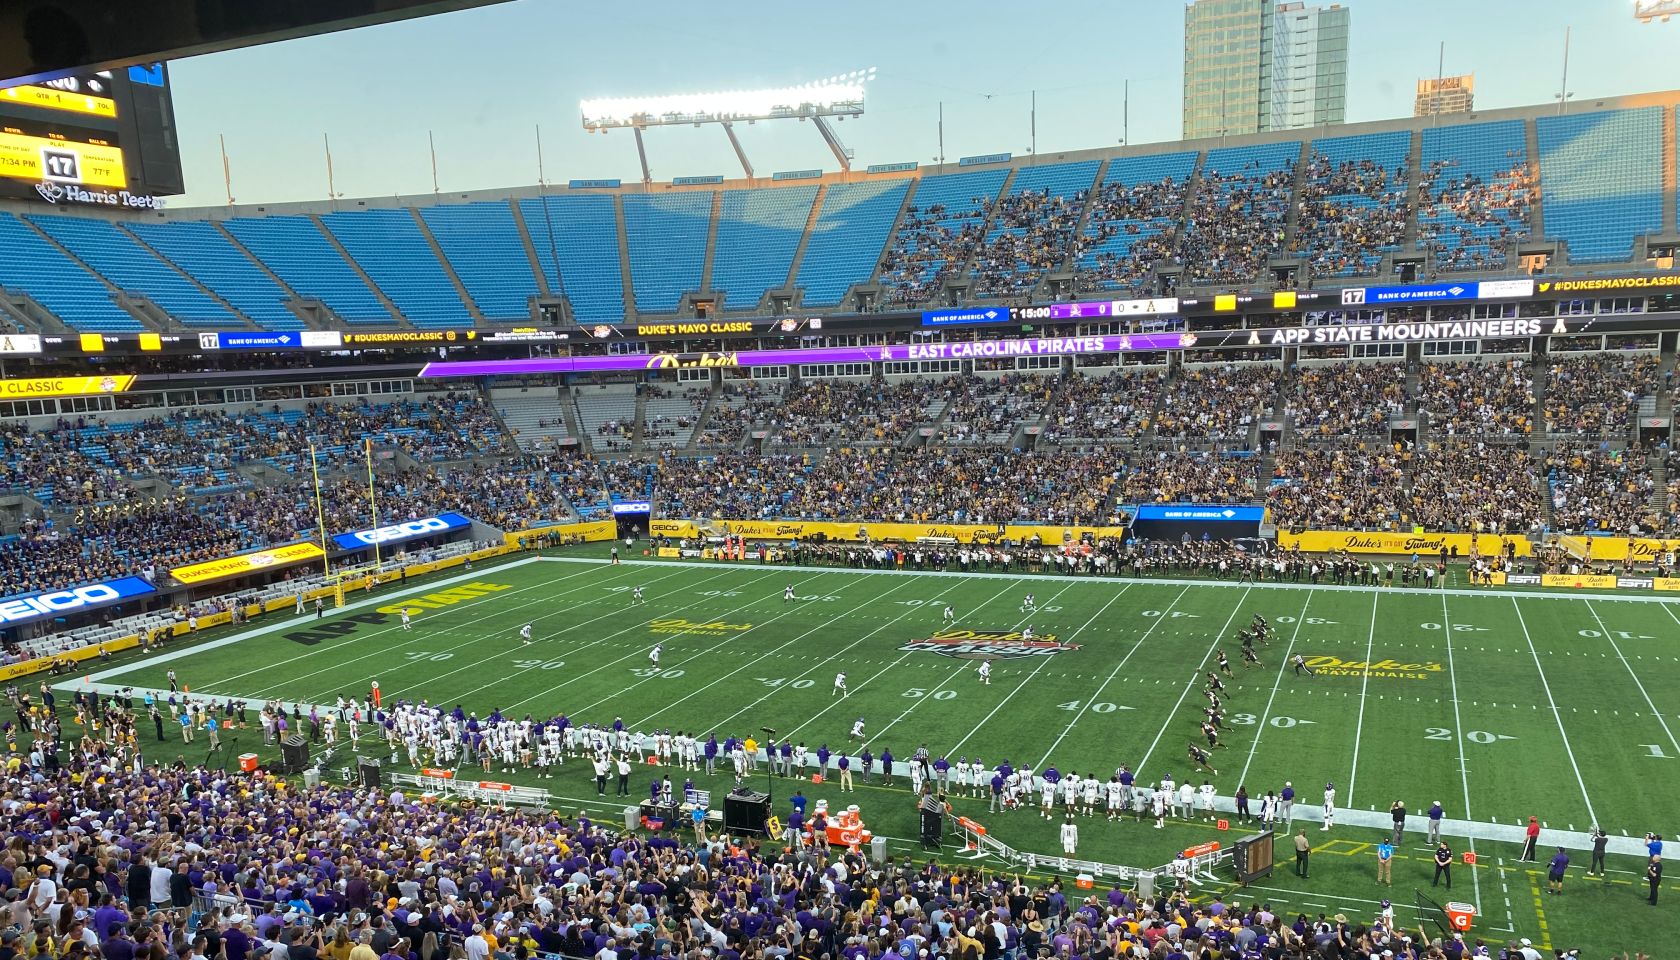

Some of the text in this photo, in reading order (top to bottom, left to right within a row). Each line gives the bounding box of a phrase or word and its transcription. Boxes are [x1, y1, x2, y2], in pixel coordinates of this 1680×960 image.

[56, 94, 61, 103] 1
[0, 157, 36, 168] 7:34 PM
[48, 155, 74, 176] 17
[65, 186, 118, 204] Harris
[1345, 291, 1362, 304] 17
[1412, 290, 1446, 298] AMERICA
[1020, 307, 1050, 319] 15:00
[1099, 305, 1106, 314] 0
[1118, 304, 1125, 313] 0
[638, 322, 753, 335] DUKE'S MAYO CLASSIC
[1271, 319, 1541, 344] APP STATE MOUNTAINEERS
[253, 337, 279, 345] AMERICA
[354, 332, 443, 342] #DUKESMAYOCLASSIC
[909, 337, 1105, 359] EAST CAROLINA PIRATES
[7, 381, 64, 394] CLASSIC
[612, 503, 650, 512] GEICO
[354, 517, 449, 544] GEICO
[734, 524, 761, 535] Duke's
[1345, 535, 1383, 549] Duke's
[1404, 537, 1446, 550] Twang!
[179, 566, 221, 579] DUKE'S
[220, 561, 250, 571] MAYO
[273, 547, 316, 559] CLASSIC
[1507, 575, 1541, 583] ESPN
[1550, 575, 1571, 583] Duke's
[1587, 576, 1608, 584] Duke's
[1617, 579, 1653, 587] ESPN
[0, 584, 119, 622] EICO
[283, 582, 513, 646] APP STATE
[1302, 656, 1447, 672] Duke's
[1314, 669, 1428, 680] MAYONNAISE
[901, 687, 958, 700] 50
[1056, 700, 1117, 713] 40
[1230, 713, 1297, 728] 30
[1424, 727, 1497, 745] 20
[240, 760, 247, 768] G
[1218, 820, 1228, 829] 30
[1465, 853, 1475, 863] 20
[1176, 865, 1186, 873] 24
[1455, 915, 1467, 926] G
